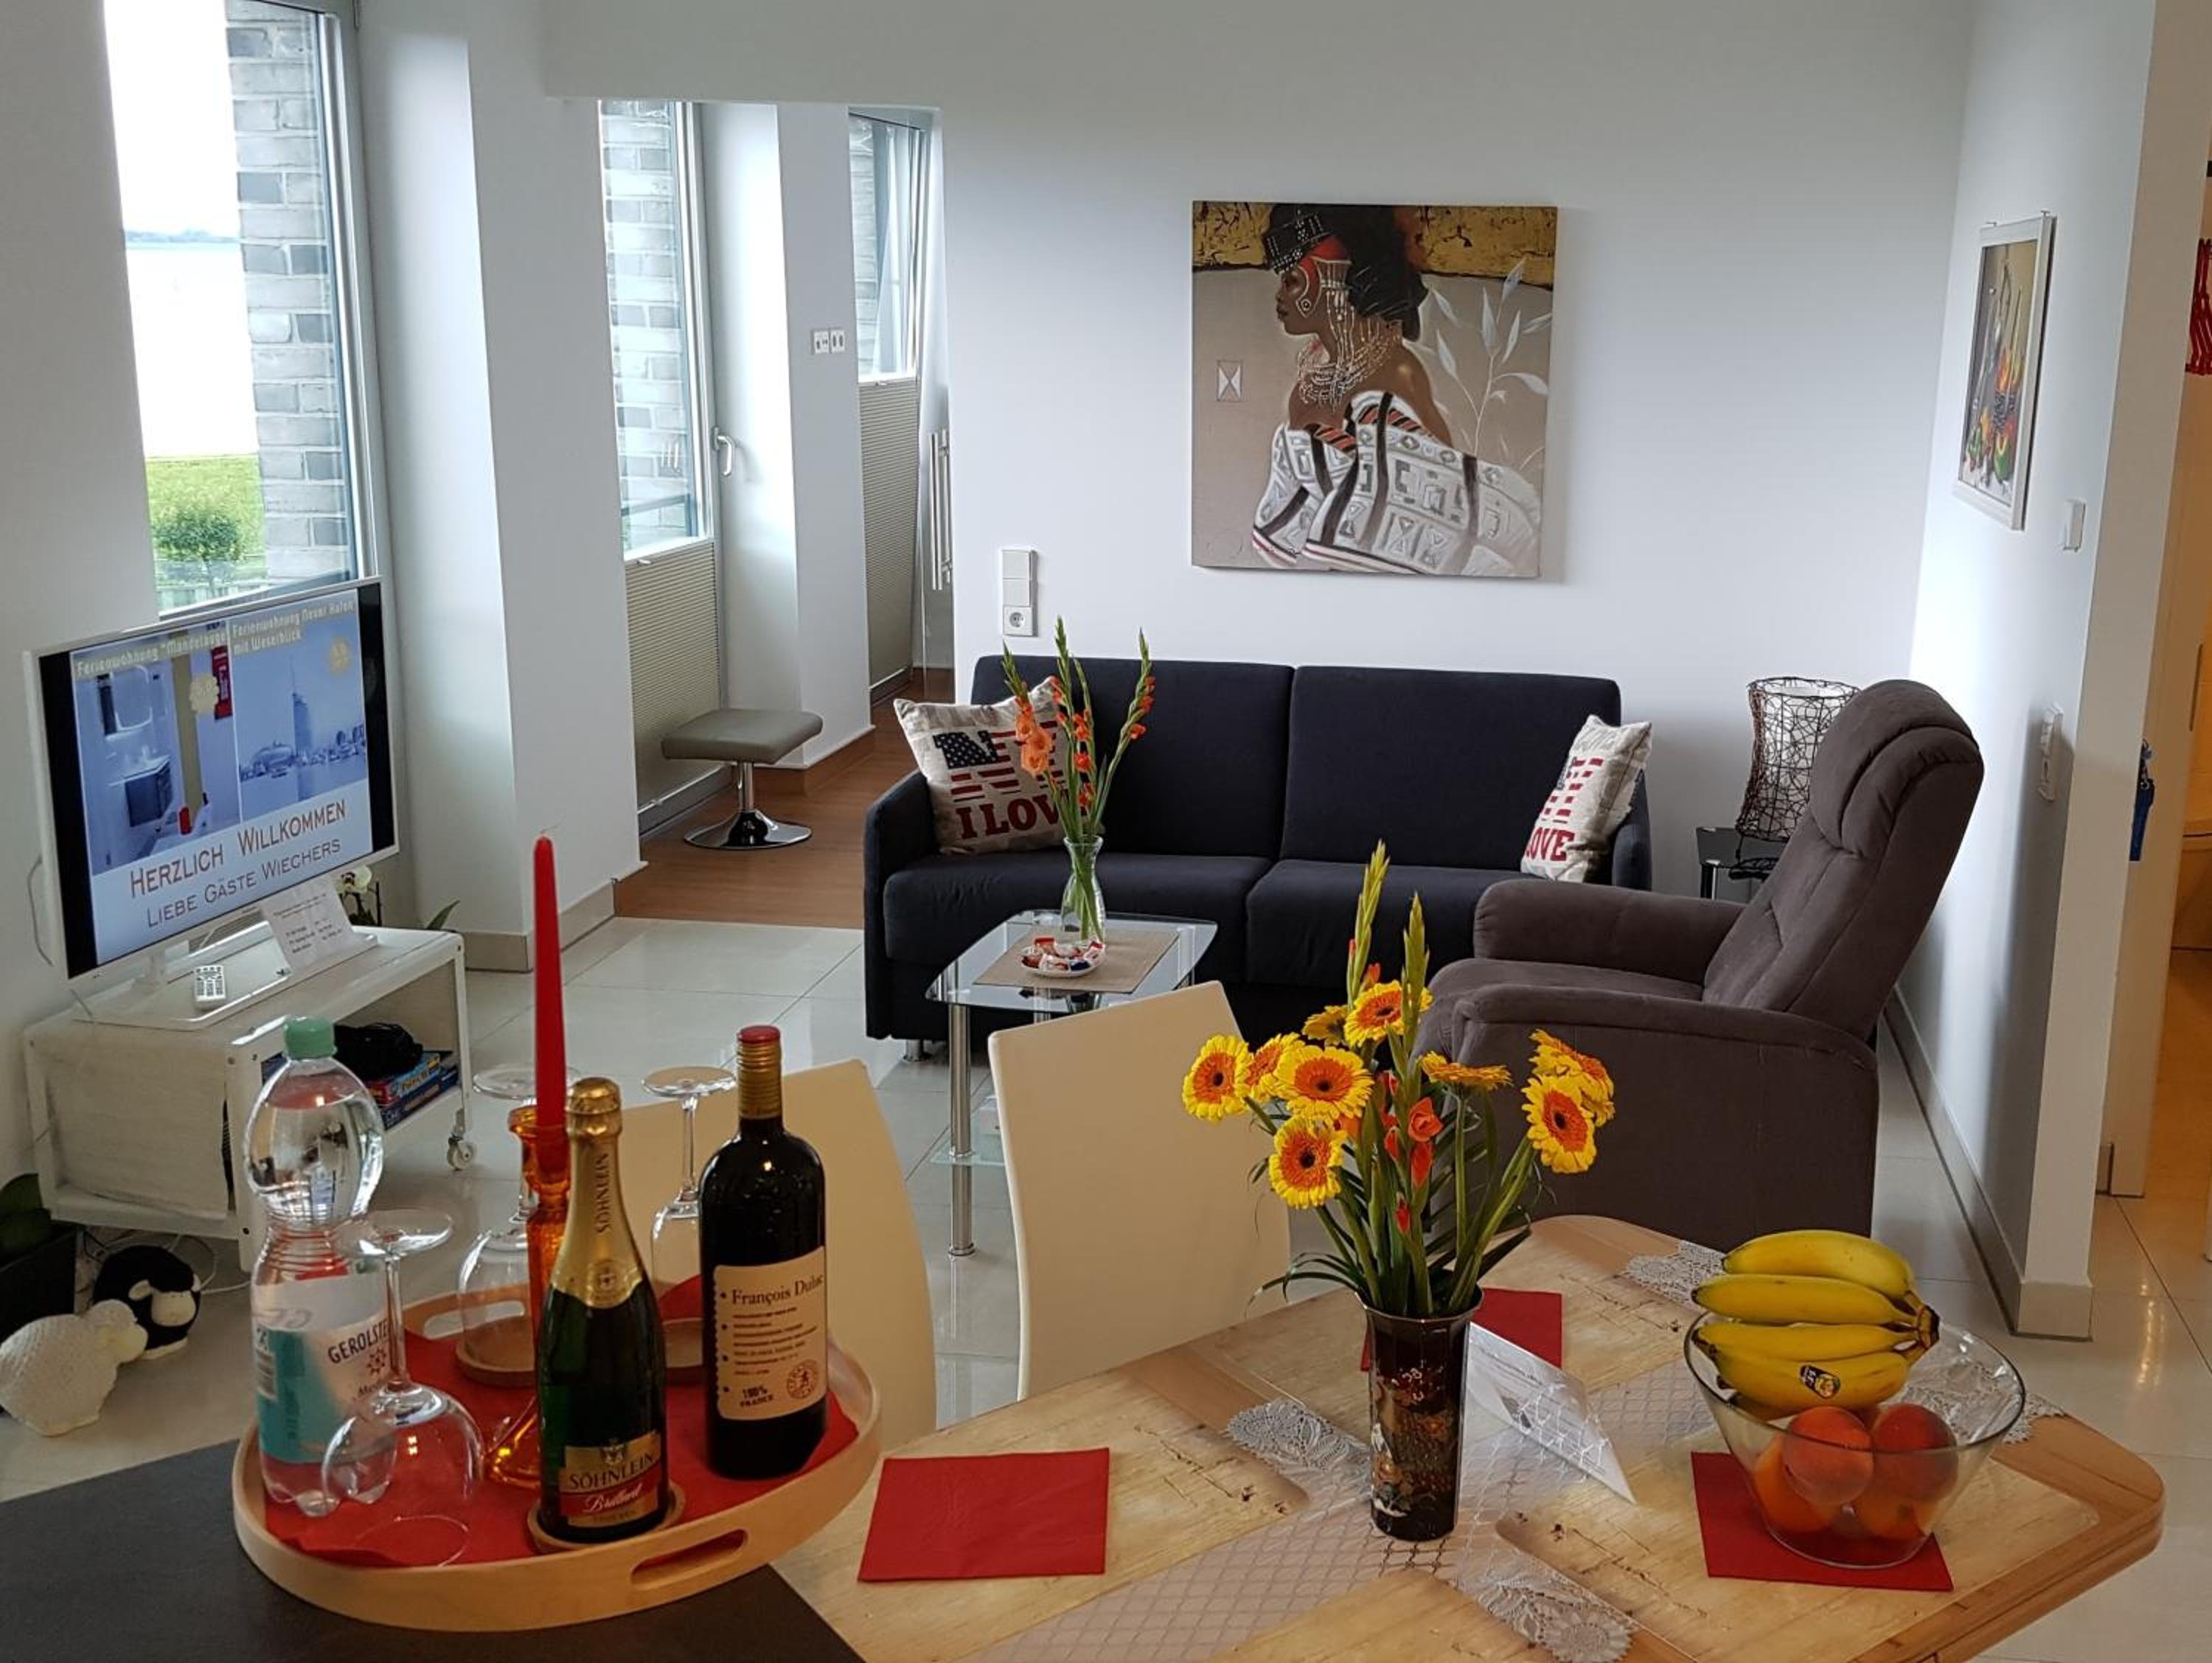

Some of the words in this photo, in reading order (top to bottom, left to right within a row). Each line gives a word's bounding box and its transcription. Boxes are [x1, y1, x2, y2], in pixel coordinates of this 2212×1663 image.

[956, 806, 978, 840] I
[978, 794, 1060, 837] LOV
[130, 843, 224, 899] HERZLICH
[237, 799, 347, 857] WILLKOMMEN
[1526, 826, 1576, 862] OVE
[147, 894, 198, 928] LIEBE
[204, 870, 257, 904] GÄSTE
[260, 838, 341, 881] WIECHERS
[732, 1286, 791, 1305] François
[327, 1318, 388, 1364] GEROLSTE
